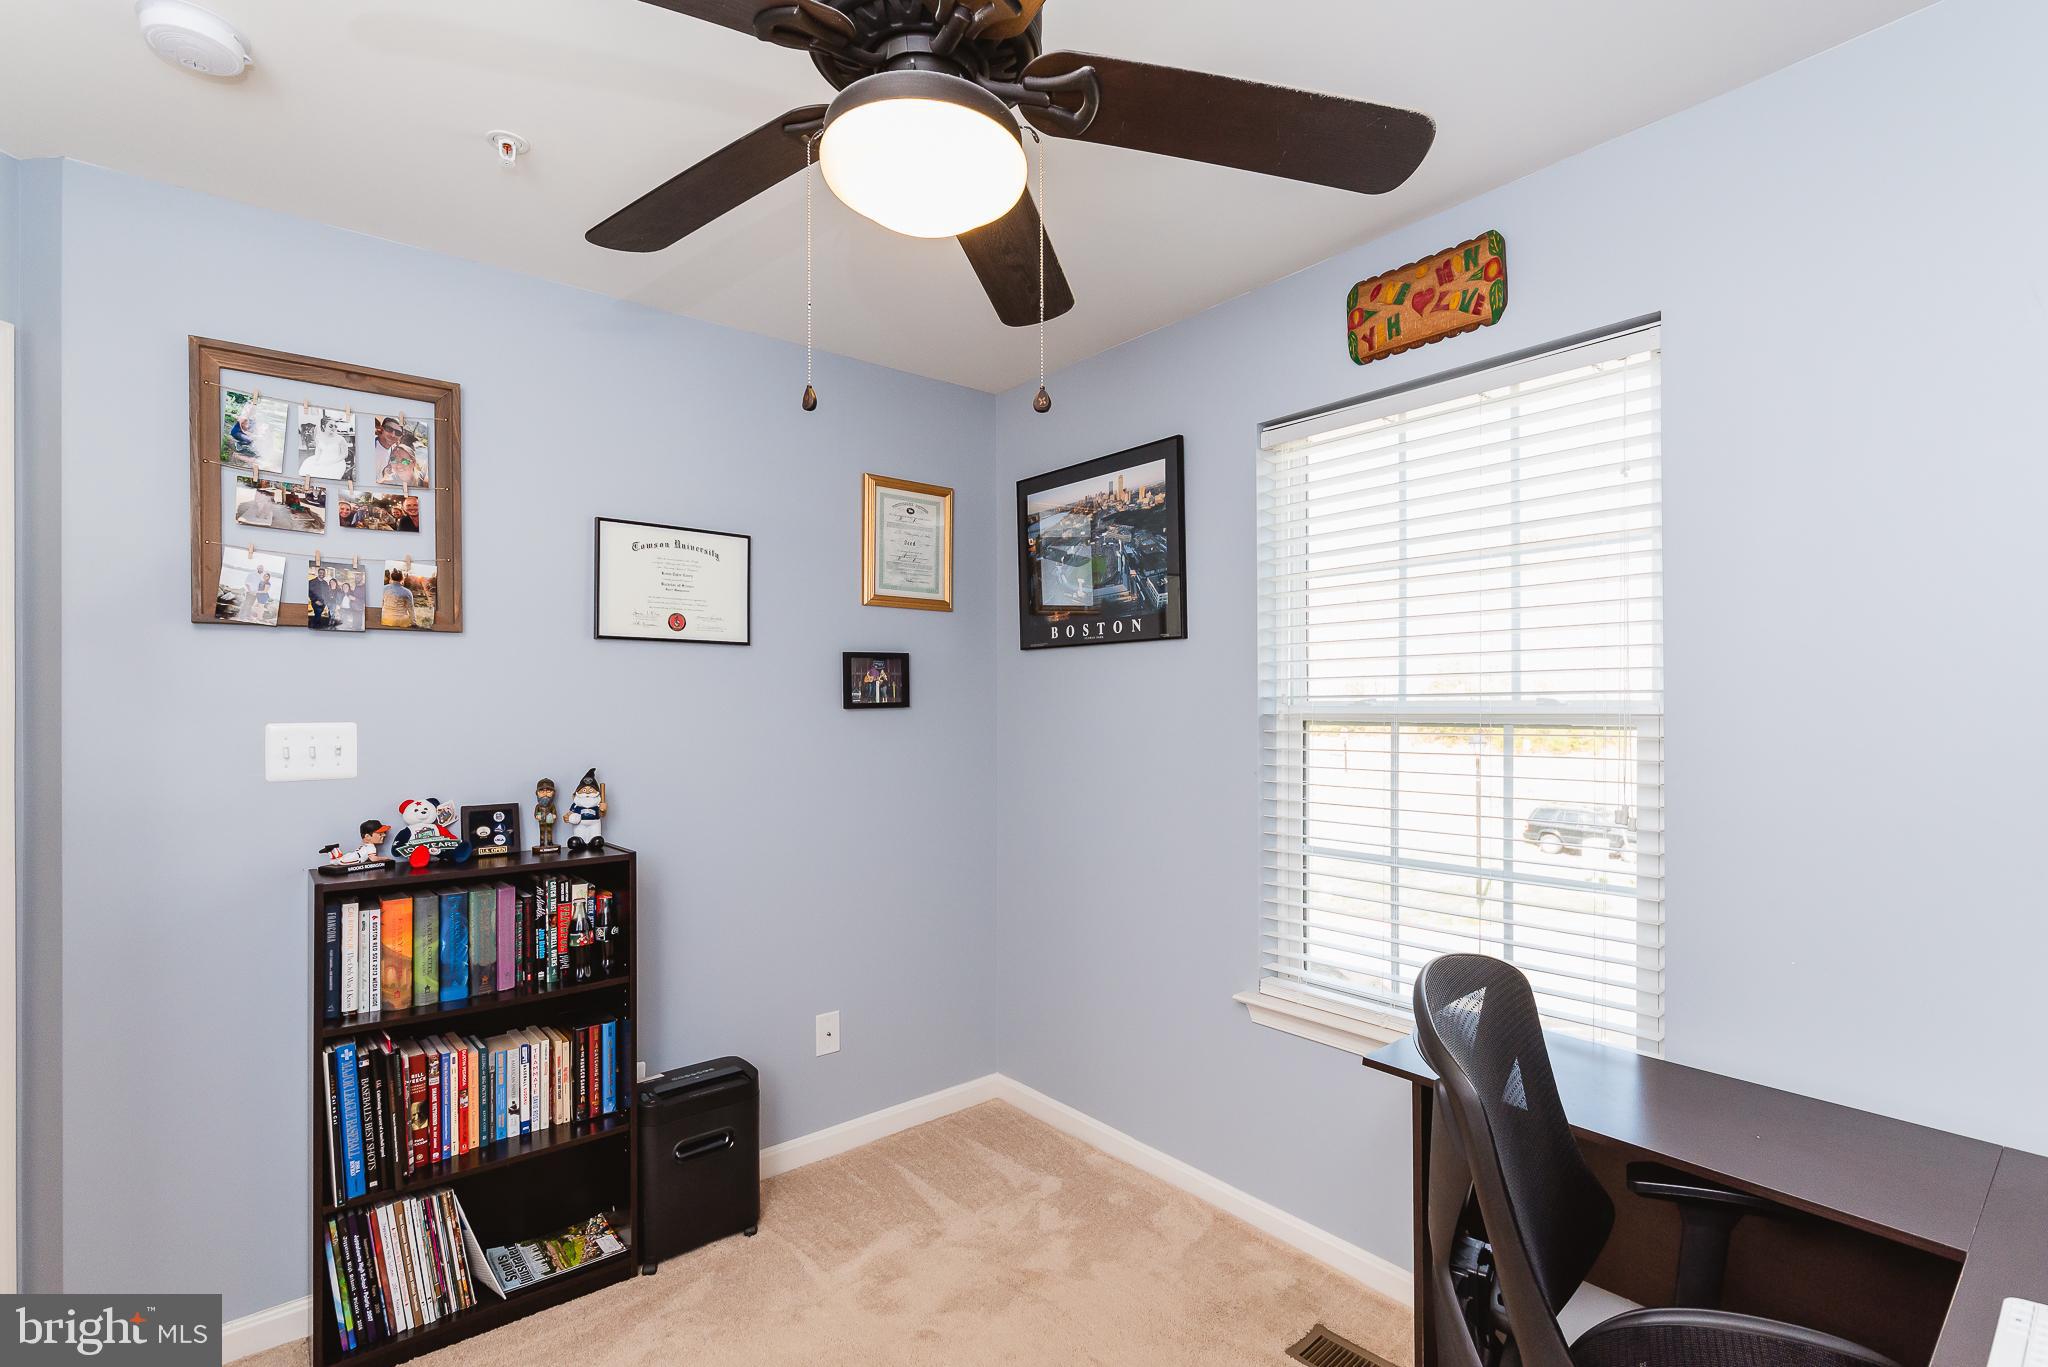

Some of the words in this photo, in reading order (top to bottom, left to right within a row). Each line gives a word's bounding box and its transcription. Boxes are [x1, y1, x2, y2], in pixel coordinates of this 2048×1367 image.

[1436, 245, 1480, 286] MON
[1430, 288, 1486, 315] LOVE
[632, 540, 670, 552] Towson
[674, 540, 720, 562] University
[1051, 618, 1142, 639] BOSTON
[404, 846, 418, 854] 10
[326, 912, 336, 943] FRANCONA
[560, 906, 570, 951] FAITHFUL
[342, 1060, 354, 1088] MAJOR
[344, 1089, 356, 1119] LEAGUE
[360, 1078, 372, 1121] BASEBALL'S
[345, 1119, 360, 1159] BASEBALL
[364, 1122, 374, 1141] BEST
[366, 1142, 376, 1171] SHOTS
[498, 1255, 517, 1282] Sports
